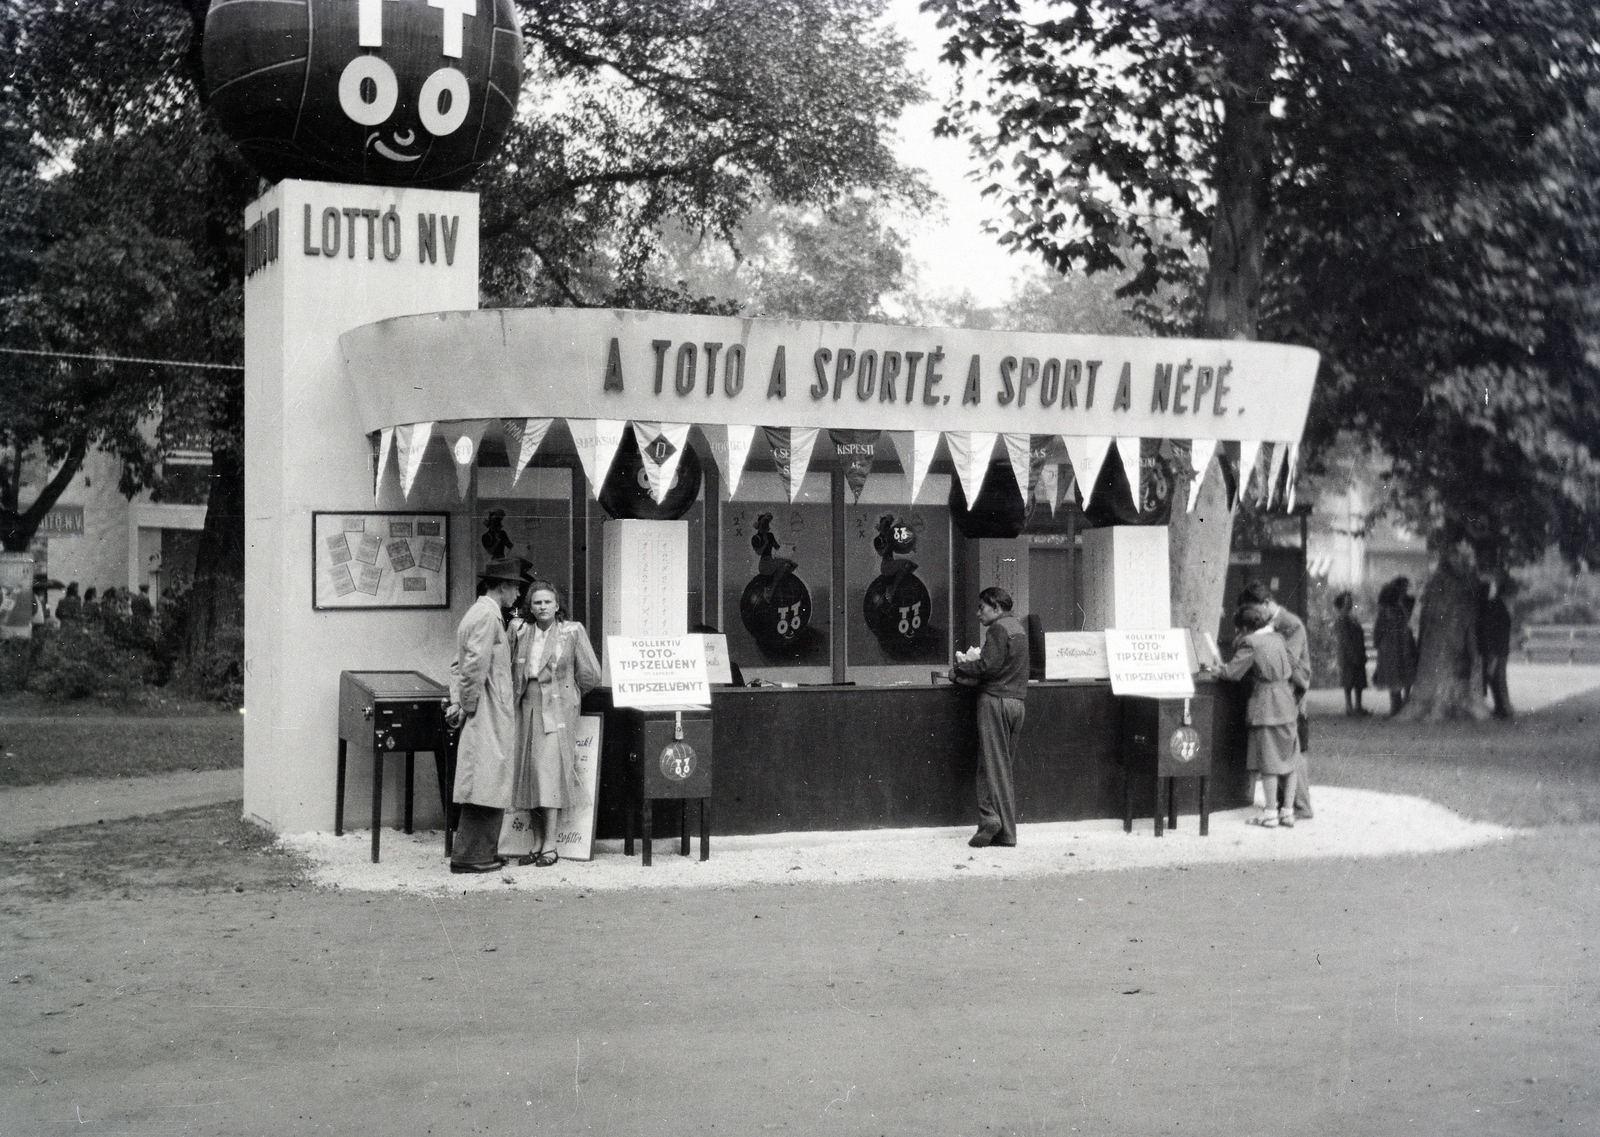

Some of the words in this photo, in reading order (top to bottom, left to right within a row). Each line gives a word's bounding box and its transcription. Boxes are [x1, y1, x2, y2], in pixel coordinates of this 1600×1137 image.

[304, 203, 400, 261] LOTTÓ
[418, 213, 459, 266] NV
[604, 337, 625, 393] A
[651, 339, 747, 398] TOTO
[767, 345, 787, 400] A
[811, 345, 951, 406] SPORTÉ,
[962, 354, 981, 406] A
[997, 356, 1102, 410] SPORT
[1113, 361, 1132, 412] A
[632, 640, 681, 648] KOLLEKTIV
[620, 658, 697, 671] TIPSZELVÉNY
